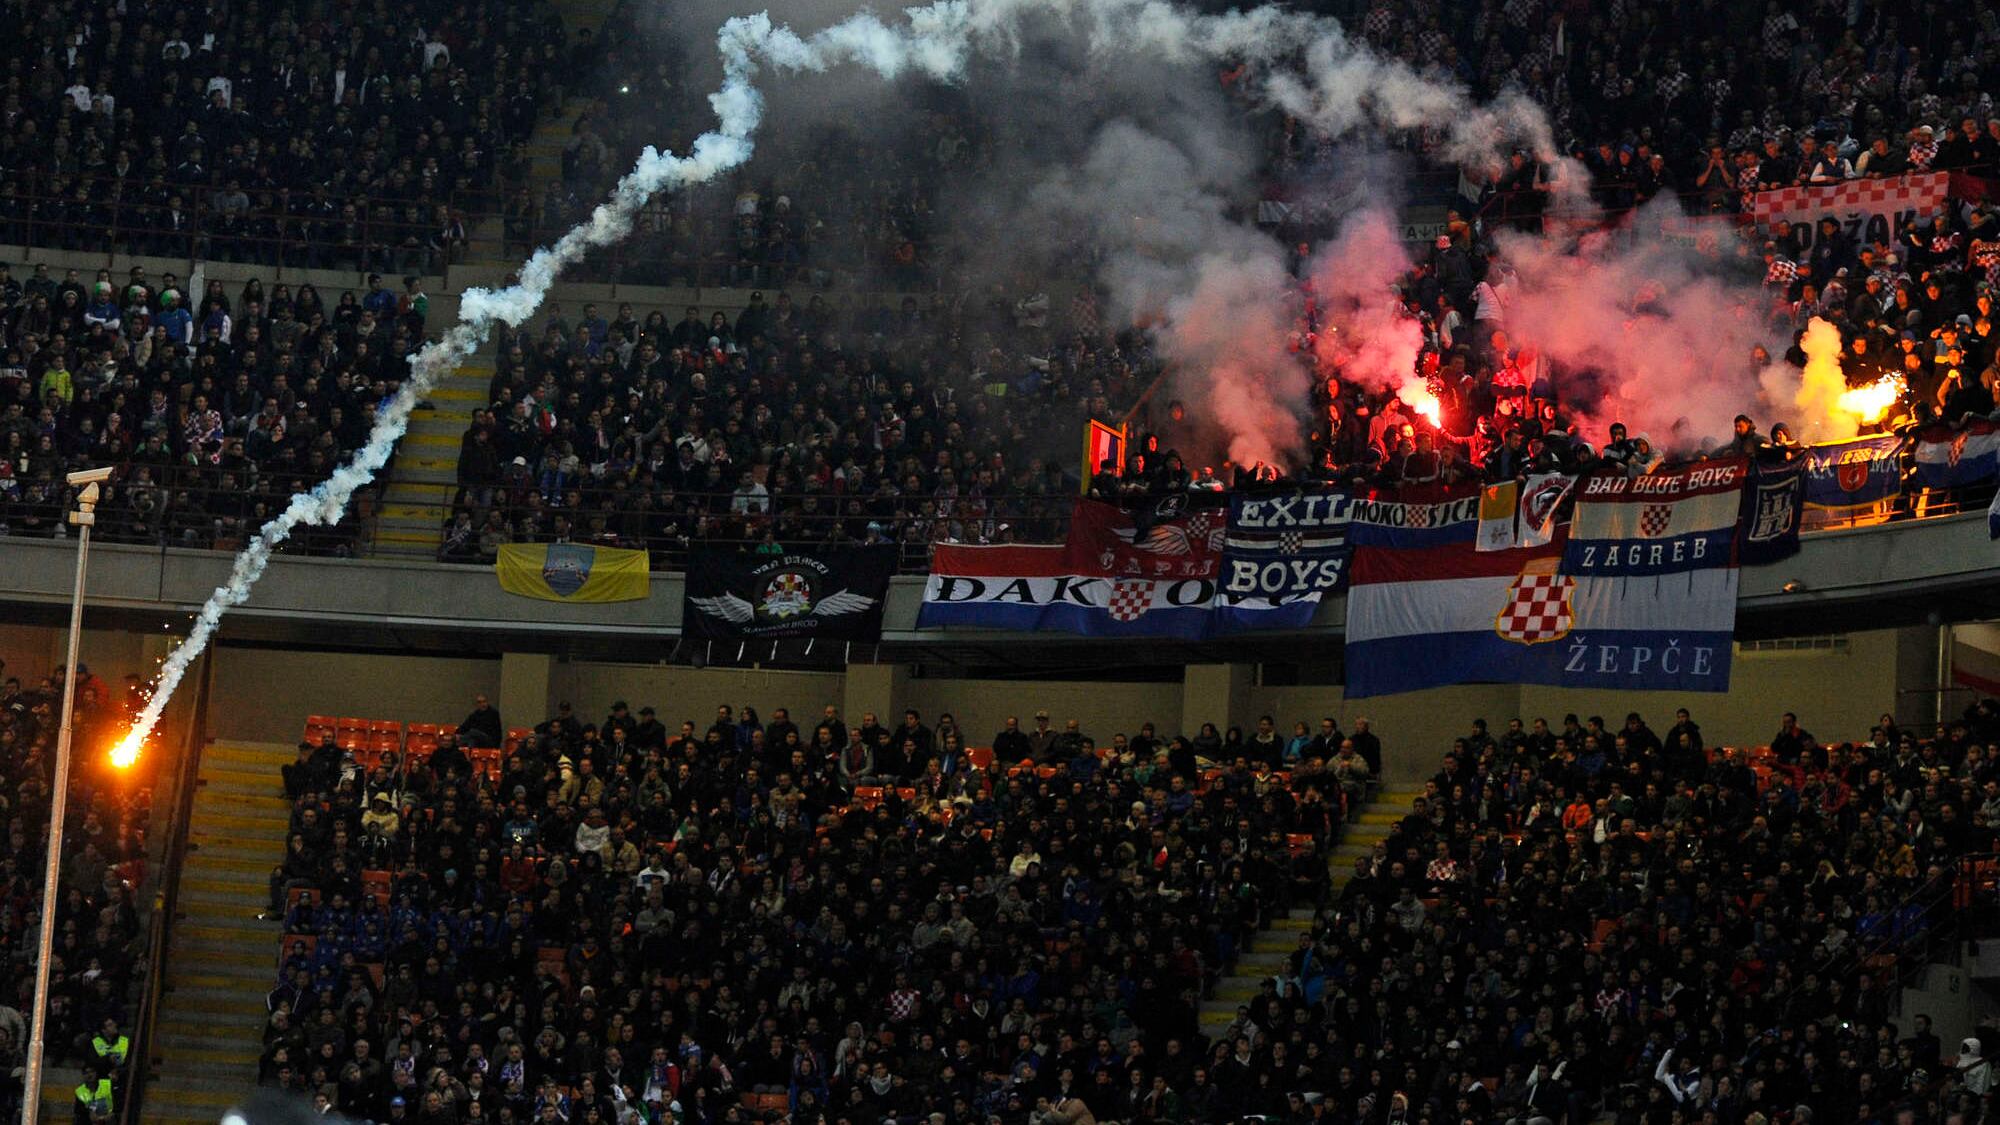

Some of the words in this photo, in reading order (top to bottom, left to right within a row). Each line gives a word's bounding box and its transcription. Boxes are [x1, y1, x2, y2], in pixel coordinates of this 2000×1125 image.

[1790, 210, 1917, 251] OŽAK
[1585, 476, 1628, 494] BAD
[1632, 475, 1683, 494] BLUE
[1687, 465, 1738, 491] BOYS
[1237, 494, 1351, 527] EXIL
[1582, 537, 1708, 567] ZAGREB
[1225, 558, 1343, 593] BOYS
[1564, 636, 1713, 676] ŽEPČE
